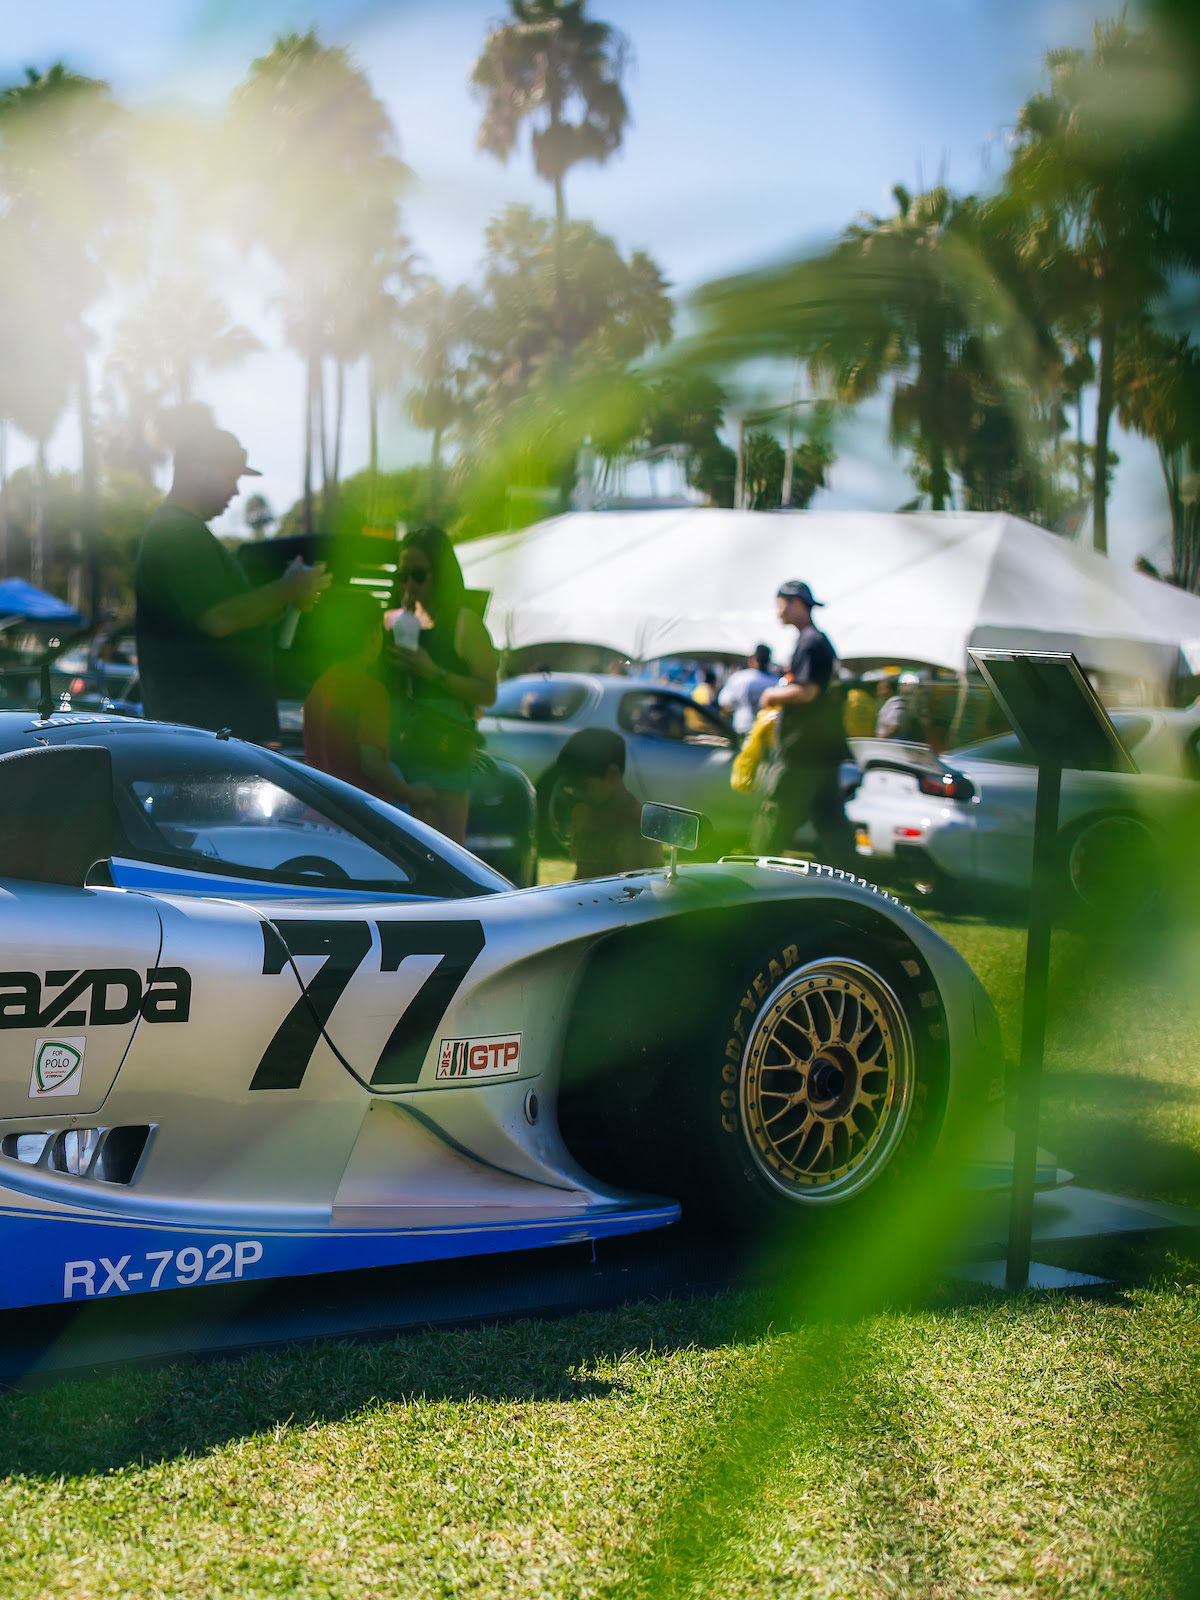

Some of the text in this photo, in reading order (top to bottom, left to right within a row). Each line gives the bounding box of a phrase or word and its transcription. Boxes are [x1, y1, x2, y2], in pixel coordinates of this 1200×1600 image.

[31, 715, 111, 728] PRICE
[248, 920, 486, 1090] 77
[45, 1058, 70, 1068] POLO
[469, 1041, 519, 1070] GTP
[63, 1240, 263, 1298] RX-792P
